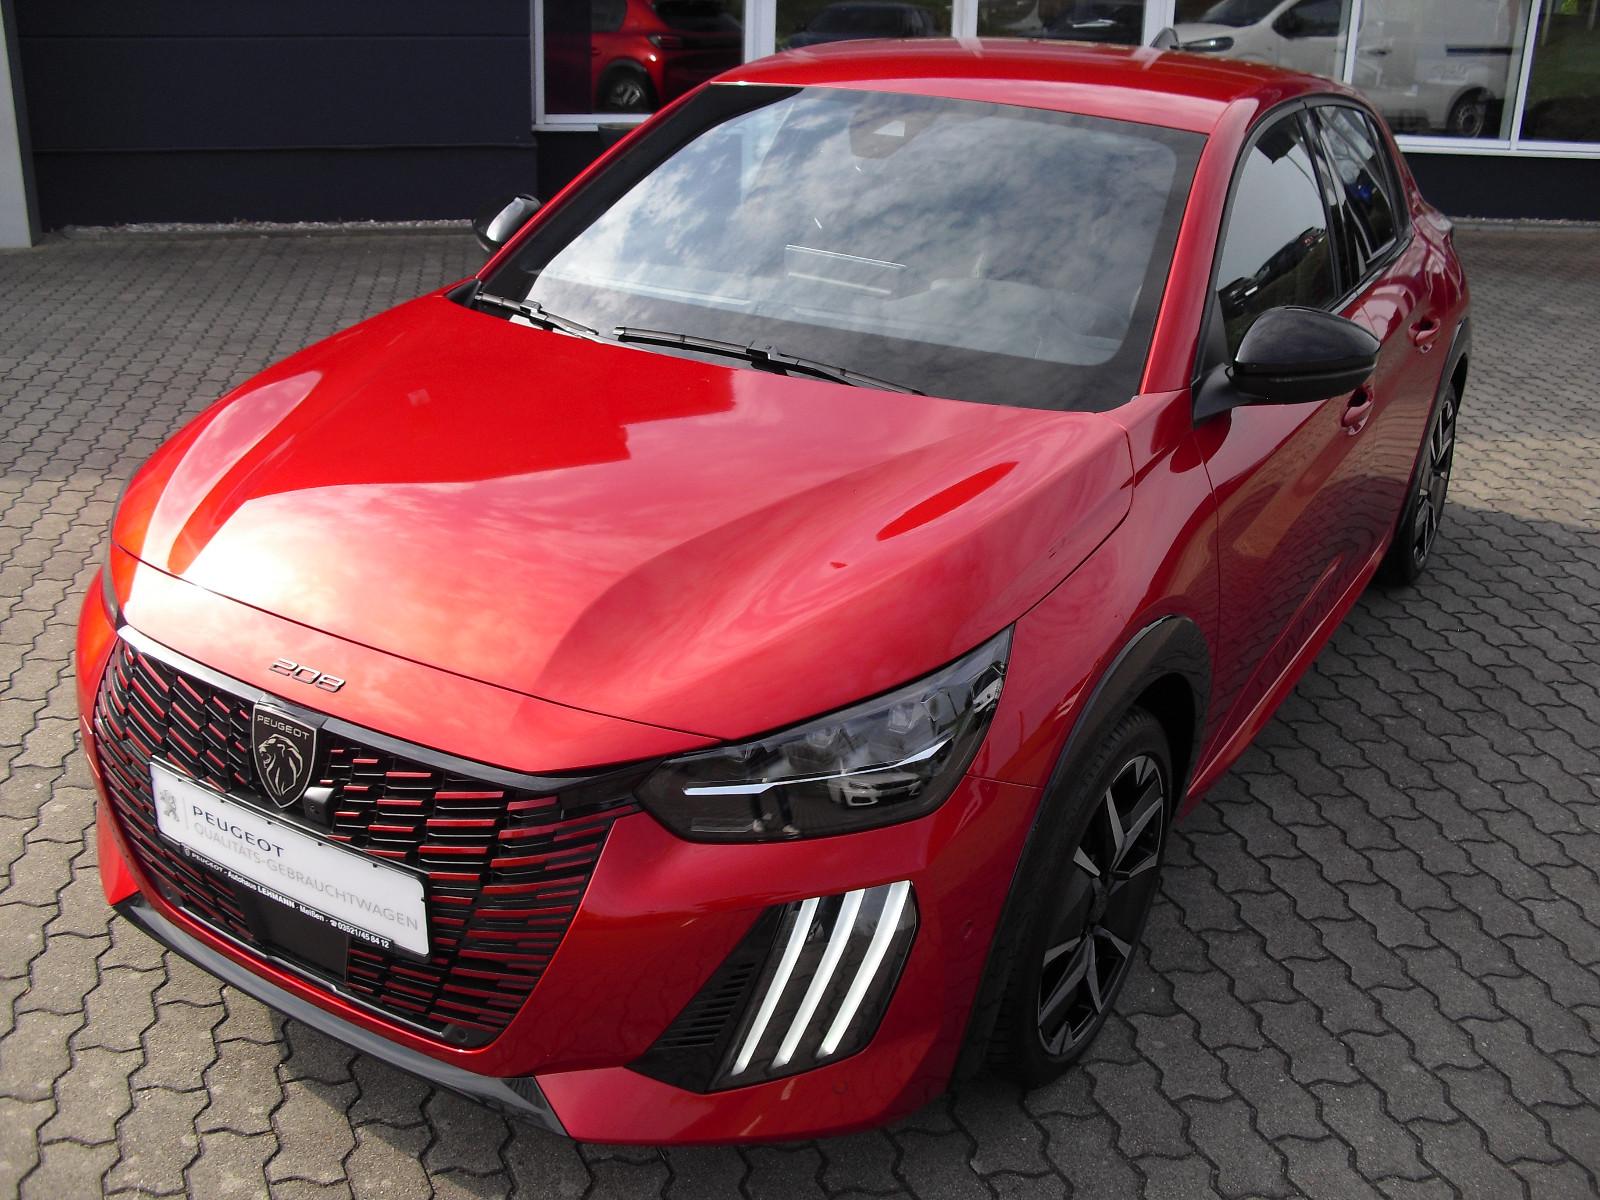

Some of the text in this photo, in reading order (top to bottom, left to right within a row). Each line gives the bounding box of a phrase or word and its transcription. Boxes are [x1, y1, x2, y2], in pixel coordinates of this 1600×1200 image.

[269, 657, 346, 693] 208
[256, 714, 310, 740] PEUGEOT
[192, 804, 285, 858] PEUGEOT
[191, 852, 223, 873] PEUGEOT
[227, 871, 257, 890] Autohaus
[257, 886, 296, 909] LEHMANN
[299, 905, 325, 922] Meißen
[380, 939, 390, 949] 12
